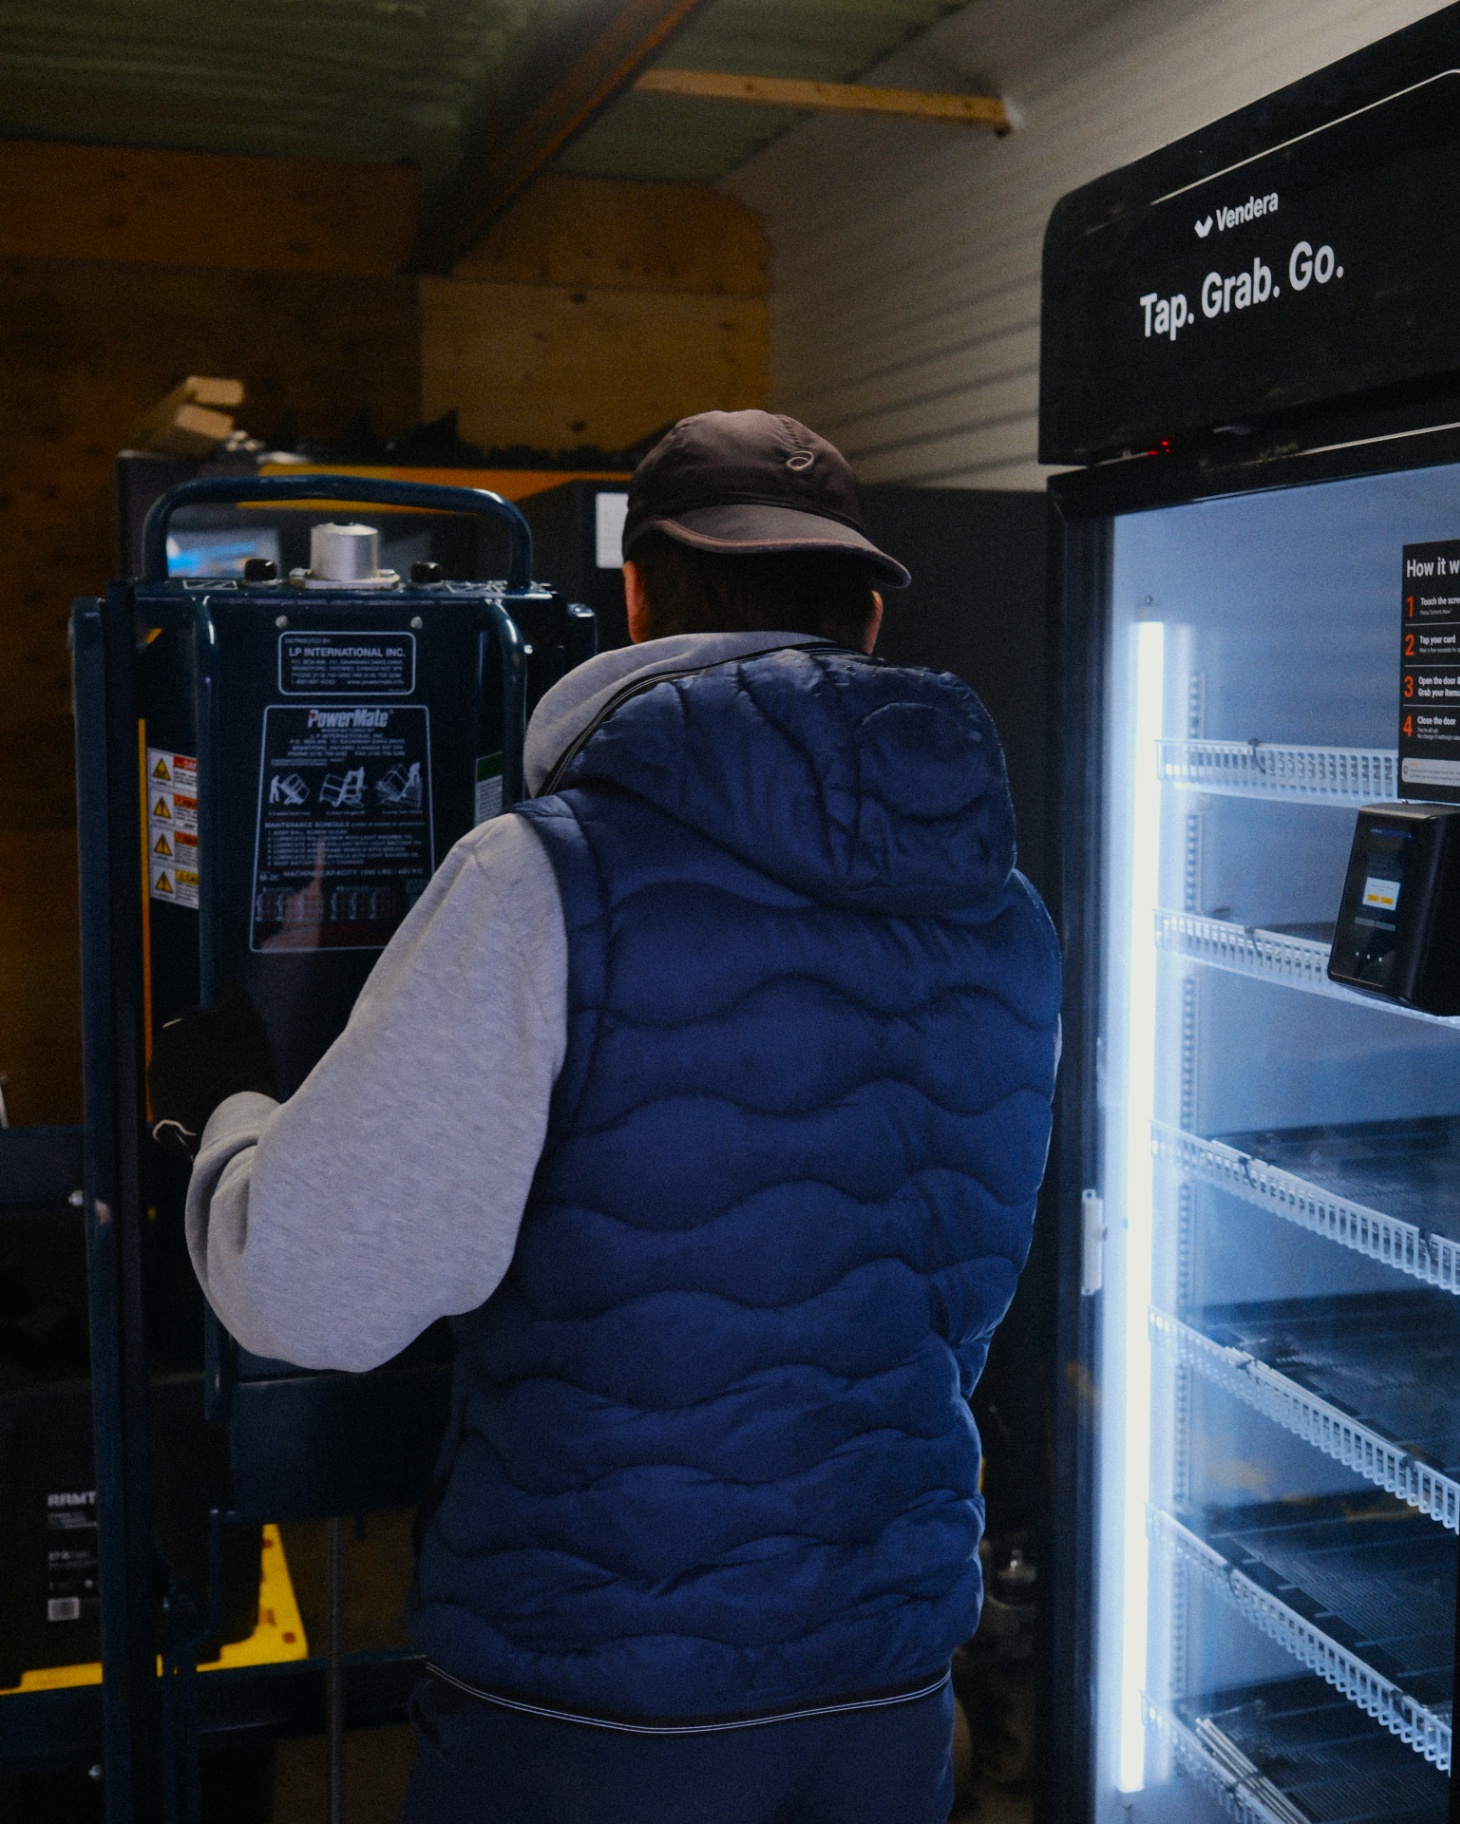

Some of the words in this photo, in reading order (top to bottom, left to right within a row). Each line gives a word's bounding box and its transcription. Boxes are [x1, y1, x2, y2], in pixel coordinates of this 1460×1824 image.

[1215, 192, 1279, 231] Vendera
[1139, 292, 1195, 341] Tap.
[1201, 257, 1280, 319] Grab.
[1288, 241, 1344, 291] Go.
[1406, 558, 1434, 578] How
[1437, 556, 1446, 575] it
[1406, 595, 1414, 617] 1
[1420, 597, 1437, 606] Touch
[1405, 633, 1414, 656] 2
[1419, 635, 1430, 646] Tap
[1430, 636, 1443, 646] your
[1443, 634, 1456, 644] card
[288, 647, 302, 657] LP
[304, 647, 383, 657] INTERNATIONAL
[385, 647, 407, 657] INC.
[1404, 675, 1414, 698] 3
[1418, 676, 1433, 687] Open
[1433, 676, 1442, 685] the
[1443, 676, 1456, 685] door
[1417, 687, 1431, 697] Grab
[1431, 689, 1444, 699] your
[1403, 715, 1413, 737] 4
[1417, 715, 1433, 725] Close
[1433, 716, 1443, 725] the
[1443, 716, 1457, 726] door
